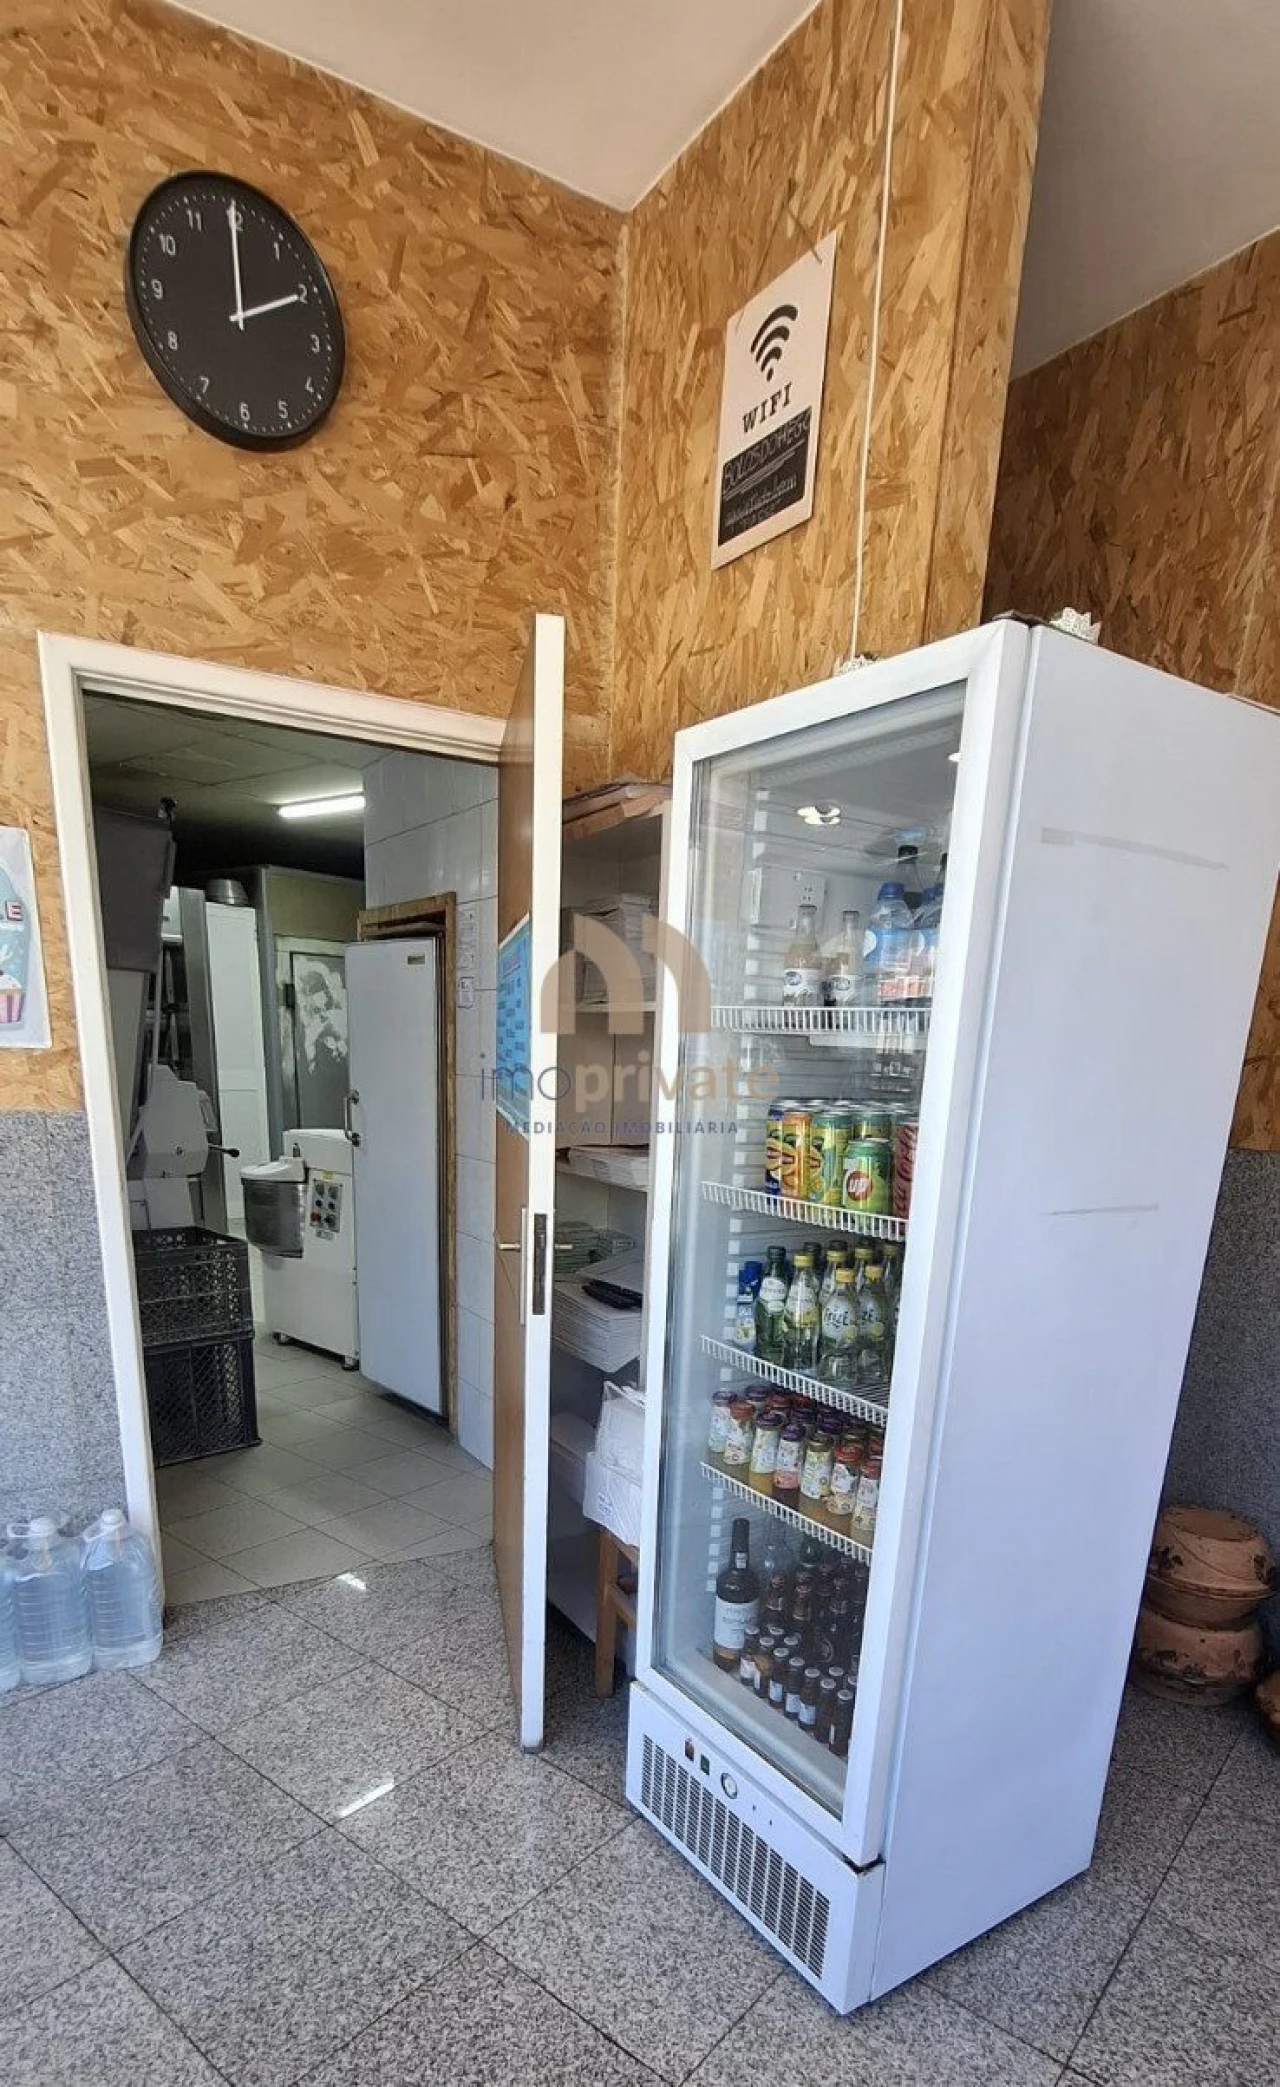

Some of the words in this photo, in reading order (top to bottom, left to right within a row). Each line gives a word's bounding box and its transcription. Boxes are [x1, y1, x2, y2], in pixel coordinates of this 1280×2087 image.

[186, 209, 202, 231] 11
[159, 233, 177, 256] 10
[273, 241, 280, 262] 1
[151, 279, 164, 300] 9
[297, 284, 308, 304] 2
[167, 331, 178, 350] 8
[310, 334, 320, 353] 3
[200, 376, 210, 394] 7
[304, 376, 315, 393] 4
[239, 402, 251, 422] 6
[277, 400, 288, 419] 5
[742, 381, 792, 433] WIFI
